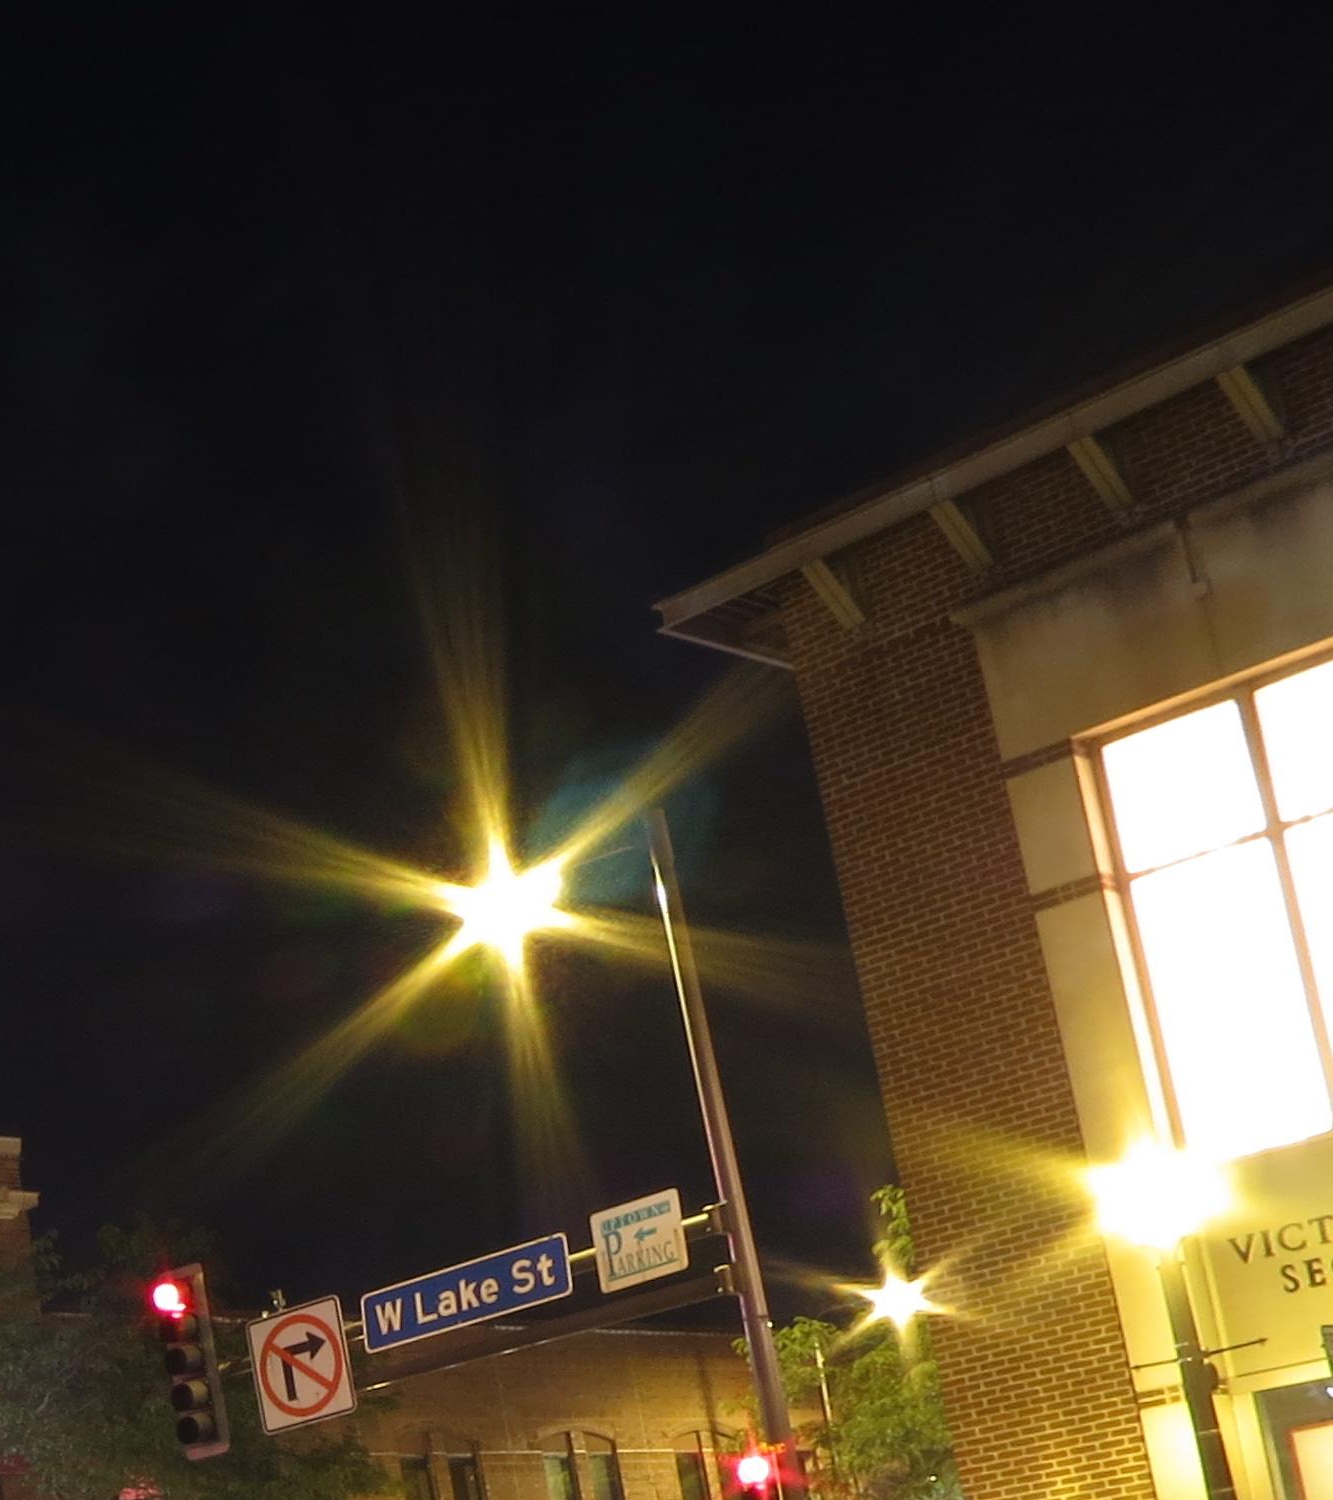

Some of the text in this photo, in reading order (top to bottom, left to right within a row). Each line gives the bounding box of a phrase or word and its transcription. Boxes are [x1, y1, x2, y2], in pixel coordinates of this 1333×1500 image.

[604, 1231, 675, 1277] PARKING
[1280, 1257, 1333, 1293] SE
[374, 1253, 556, 1336] W Lake St
